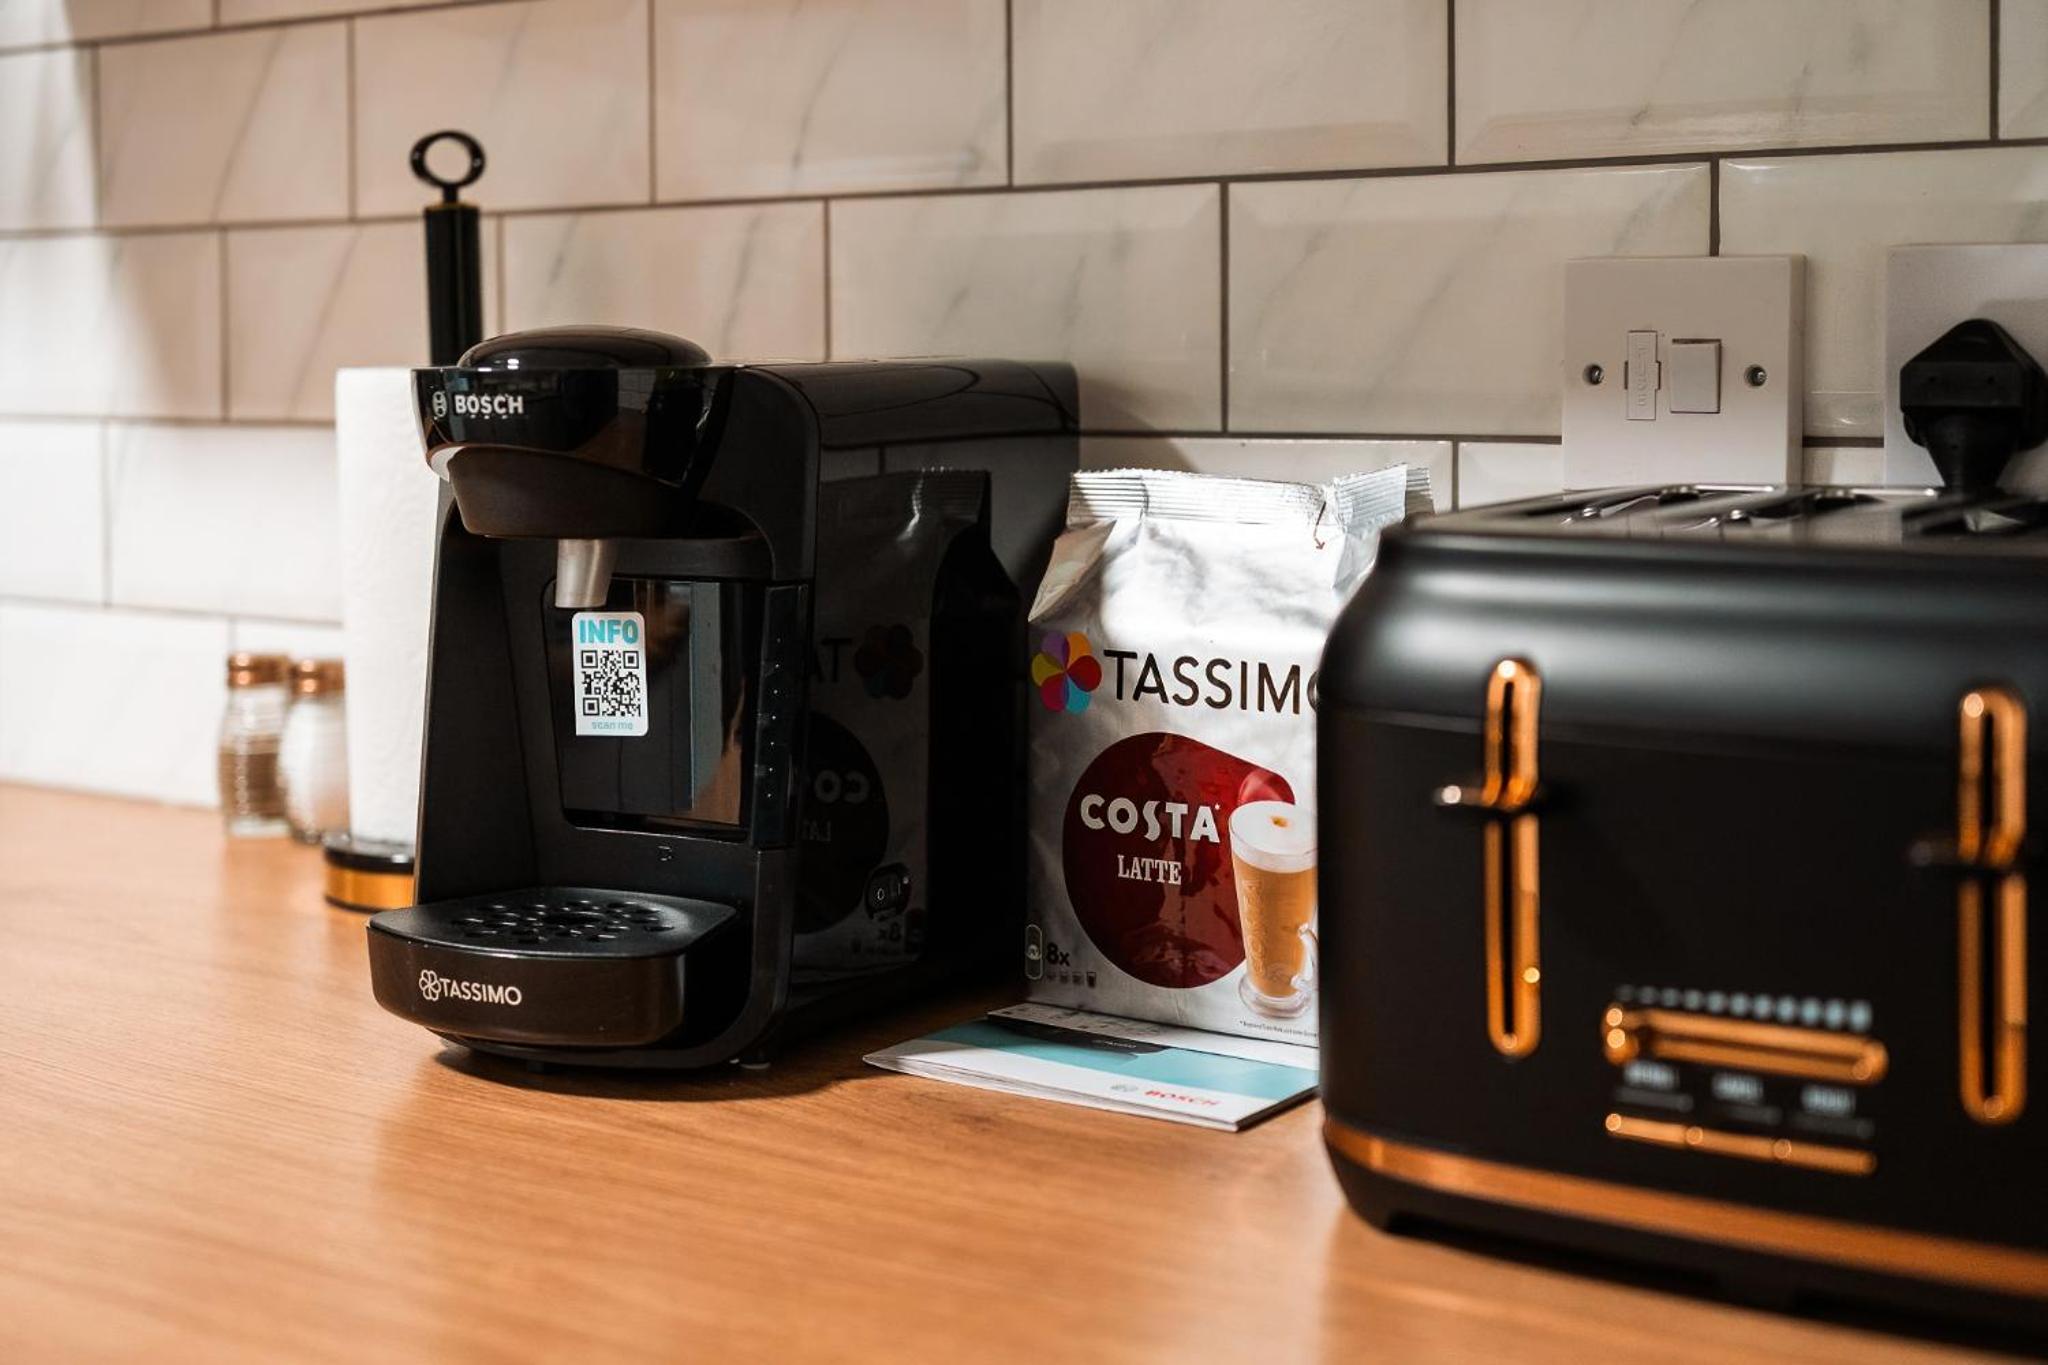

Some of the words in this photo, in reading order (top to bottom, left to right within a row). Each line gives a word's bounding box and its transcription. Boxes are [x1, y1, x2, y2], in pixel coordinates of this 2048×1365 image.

[454, 394, 525, 415] BOSCH
[578, 619, 639, 644] INFO
[1103, 649, 1318, 715] TASSIM
[591, 721, 616, 730] scan
[618, 721, 634, 730] me
[1080, 794, 1220, 843] COSTA
[1117, 854, 1182, 885] LATTE
[1047, 942, 1071, 966] 8x
[439, 978, 522, 1005] TASSIMO
